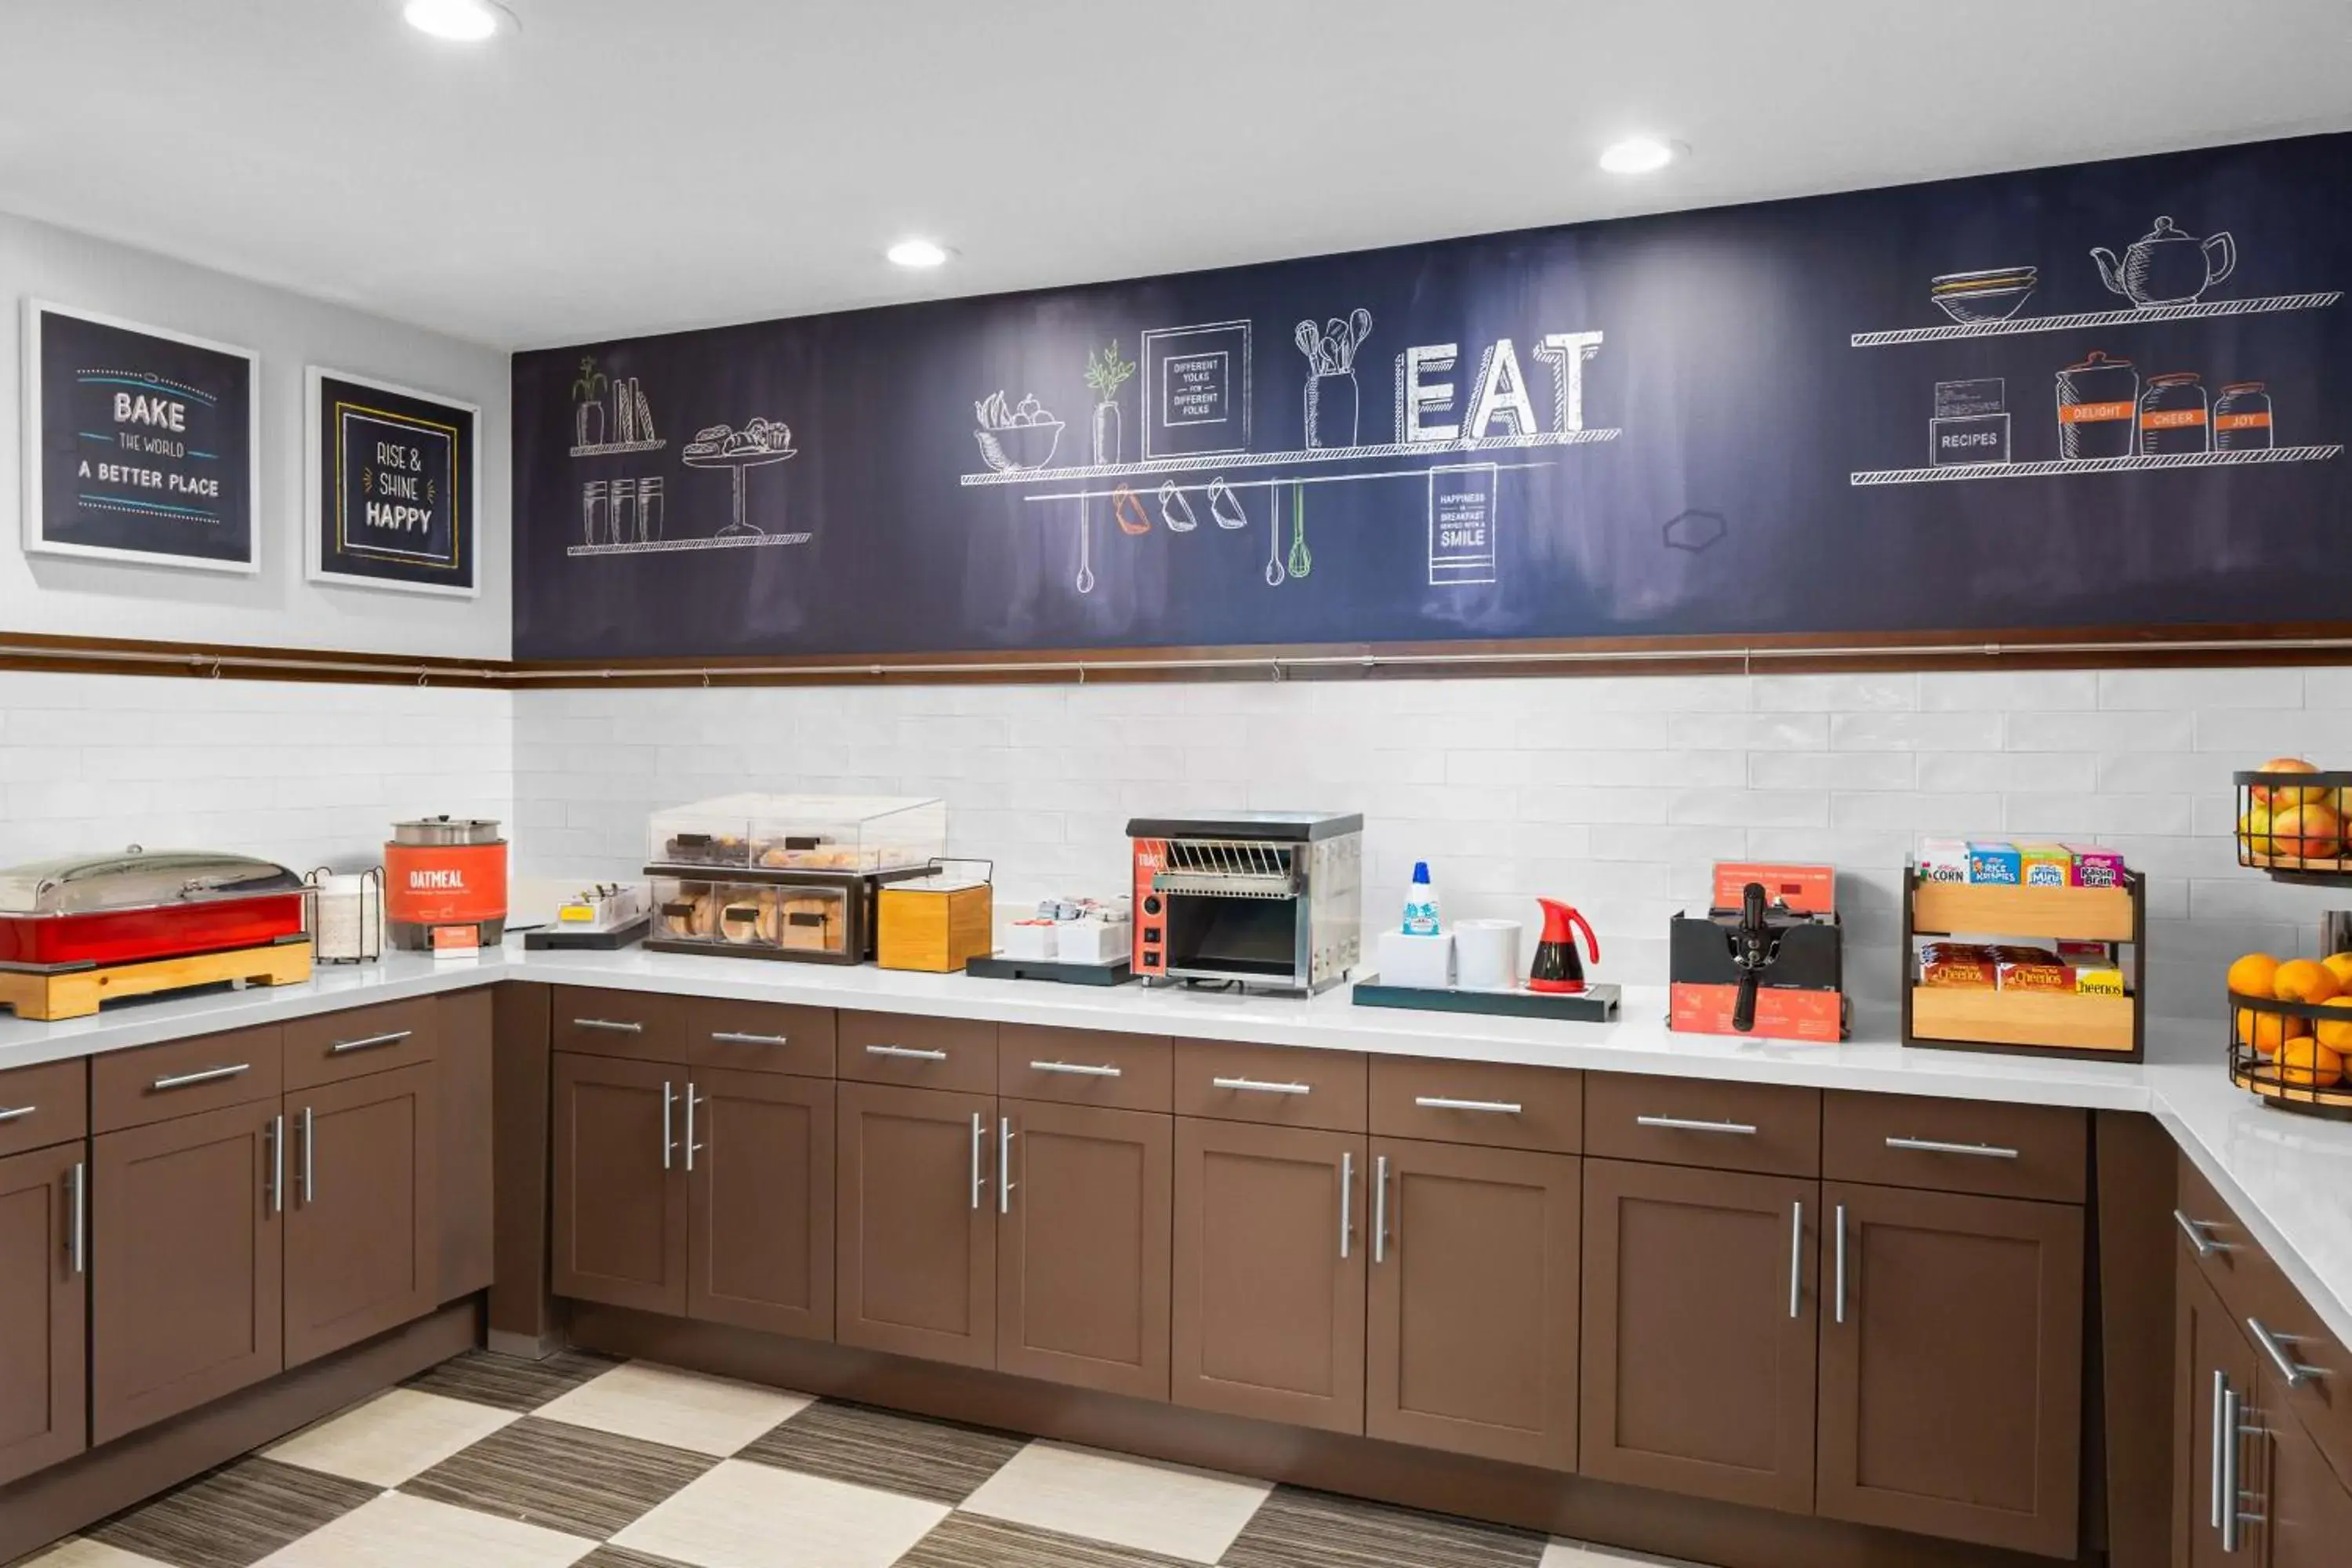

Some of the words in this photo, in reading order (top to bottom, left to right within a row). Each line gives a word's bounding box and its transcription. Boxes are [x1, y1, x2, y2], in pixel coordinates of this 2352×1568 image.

[1174, 360, 1218, 373] DIFFERENT
[1183, 372, 1210, 383] YOLKS
[1396, 331, 1603, 443] EAT
[1174, 393, 1218, 405] DIFFERENT
[114, 392, 186, 432] BAKE
[1183, 405, 1210, 415] FOLKS
[2073, 406, 2122, 419] DELIGHT
[2153, 413, 2194, 426] CHEER
[2232, 415, 2256, 426] JOY
[119, 432, 140, 452] THE
[143, 437, 183, 459] WORLD
[1942, 432, 1998, 448] RECIPES
[377, 441, 407, 470] RISE
[410, 448, 422, 472] &
[78, 459, 91, 478] A
[98, 463, 162, 488] BETTER
[169, 474, 220, 497] PLACE
[379, 472, 419, 501] SHINE
[1440, 493, 1485, 504] HAPPINESS
[365, 501, 433, 535] HAPPY
[1441, 529, 1486, 547] SMILE
[1984, 864, 2007, 873] RICE
[2082, 868, 2115, 877] Raisin
[410, 869, 464, 888] OATMEAL
[1933, 870, 1964, 882] CORN
[2085, 877, 2112, 885] Bran
[1938, 967, 1983, 982] Cheerios
[2015, 970, 2062, 985] Cheerios
